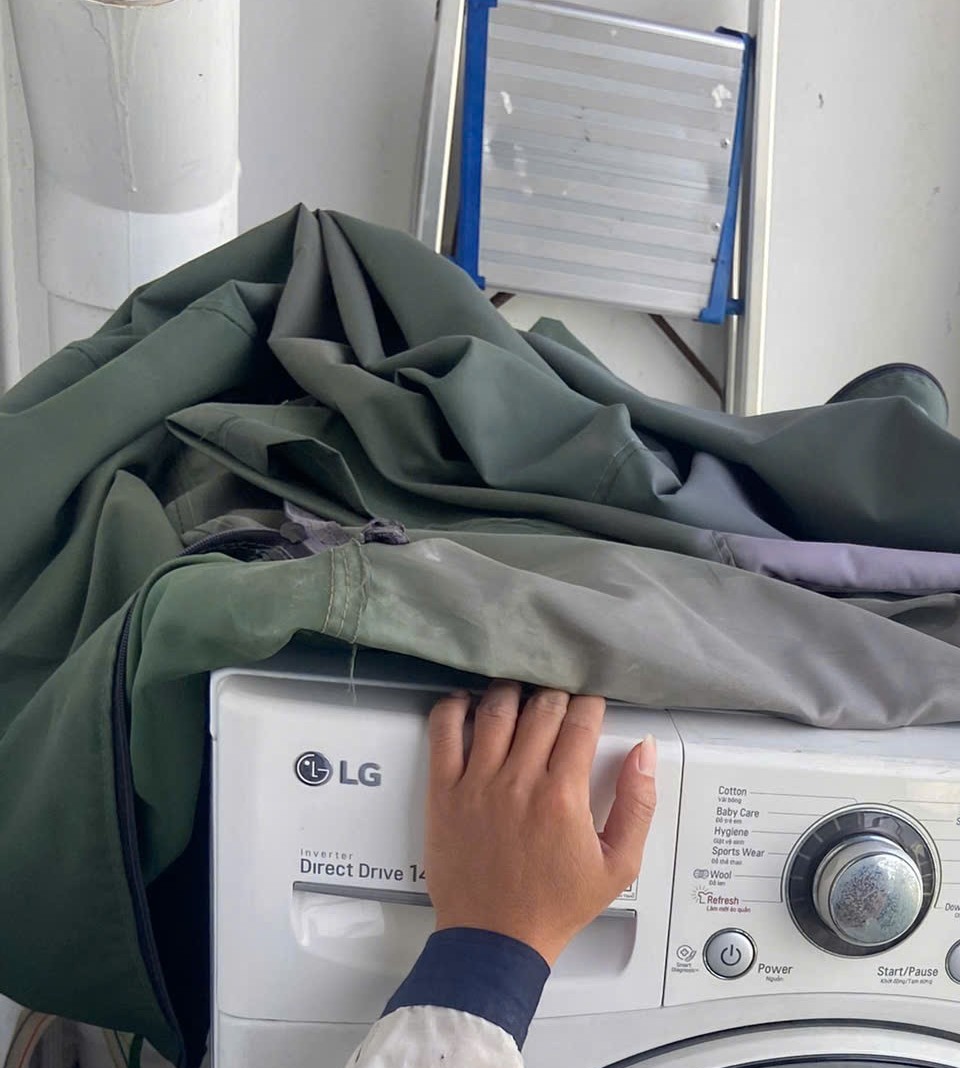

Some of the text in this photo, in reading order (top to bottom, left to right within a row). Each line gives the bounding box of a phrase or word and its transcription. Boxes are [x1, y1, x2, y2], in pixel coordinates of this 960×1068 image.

[339, 760, 382, 787] LG
[718, 785, 747, 796] Cotton
[716, 806, 760, 818] Baby Care
[714, 826, 749, 838] Hygiene
[300, 848, 354, 860] Inverter
[711, 846, 765, 857] Sports Wear
[300, 858, 354, 877] Direct
[358, 863, 404, 881] Drive
[710, 870, 732, 879] Wool
[707, 895, 739, 905] Refresh
[757, 963, 793, 974] Power
[877, 966, 939, 977] Start/Pause
